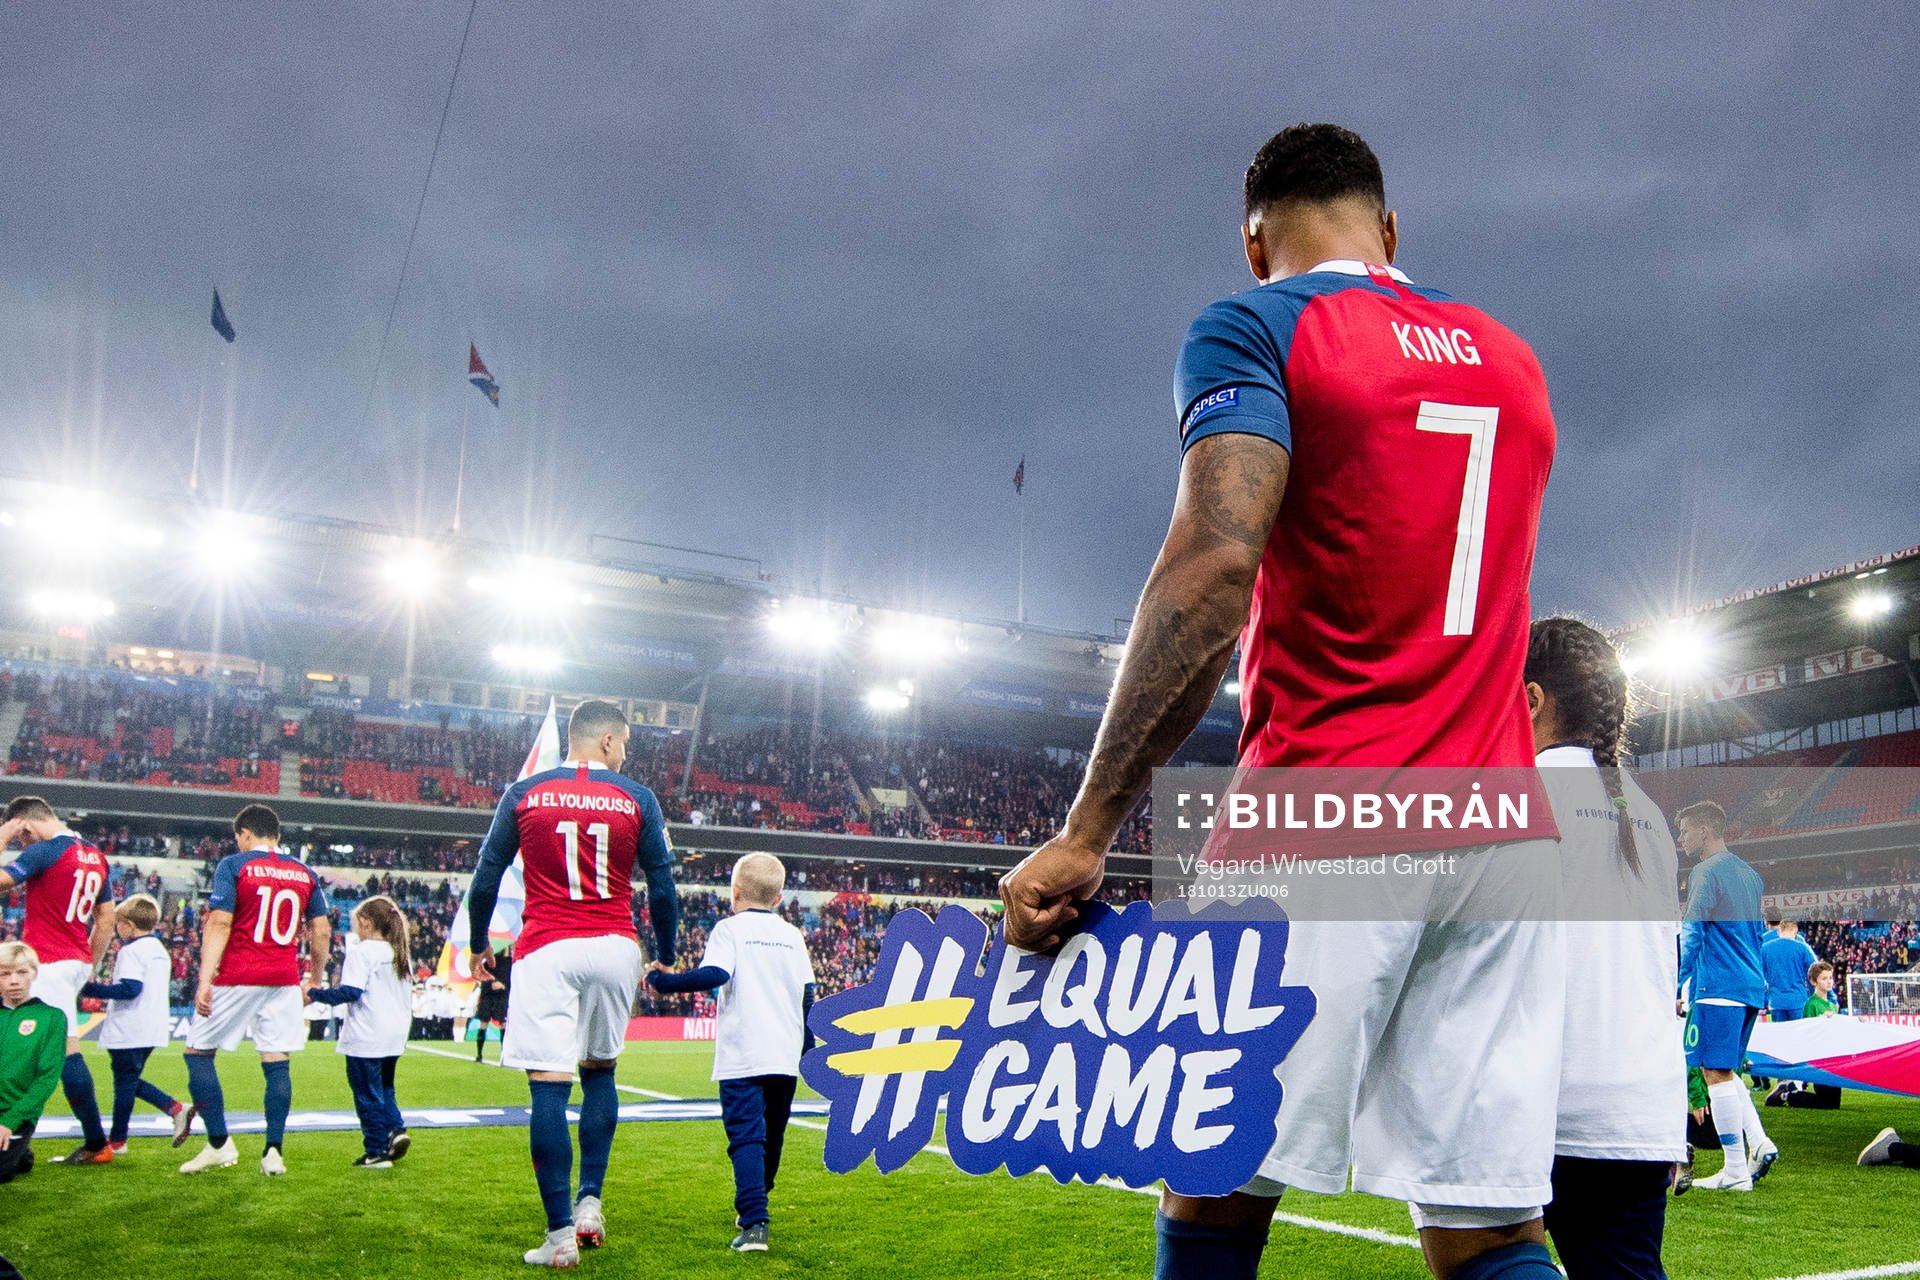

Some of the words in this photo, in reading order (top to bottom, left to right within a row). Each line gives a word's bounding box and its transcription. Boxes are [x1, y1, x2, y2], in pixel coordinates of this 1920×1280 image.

[1391, 321, 1482, 366] KING
[1415, 400, 1500, 637] 7
[310, 696, 361, 711] PPING
[527, 794, 539, 809] M
[541, 791, 637, 815] ELYOUNOUSSI
[555, 820, 613, 901] 11
[65, 868, 102, 923] 18
[253, 885, 300, 946] 10
[1784, 893, 1820, 907] VG
[987, 927, 1285, 1038] EQUAL
[961, 1039, 1242, 1153] GAME
